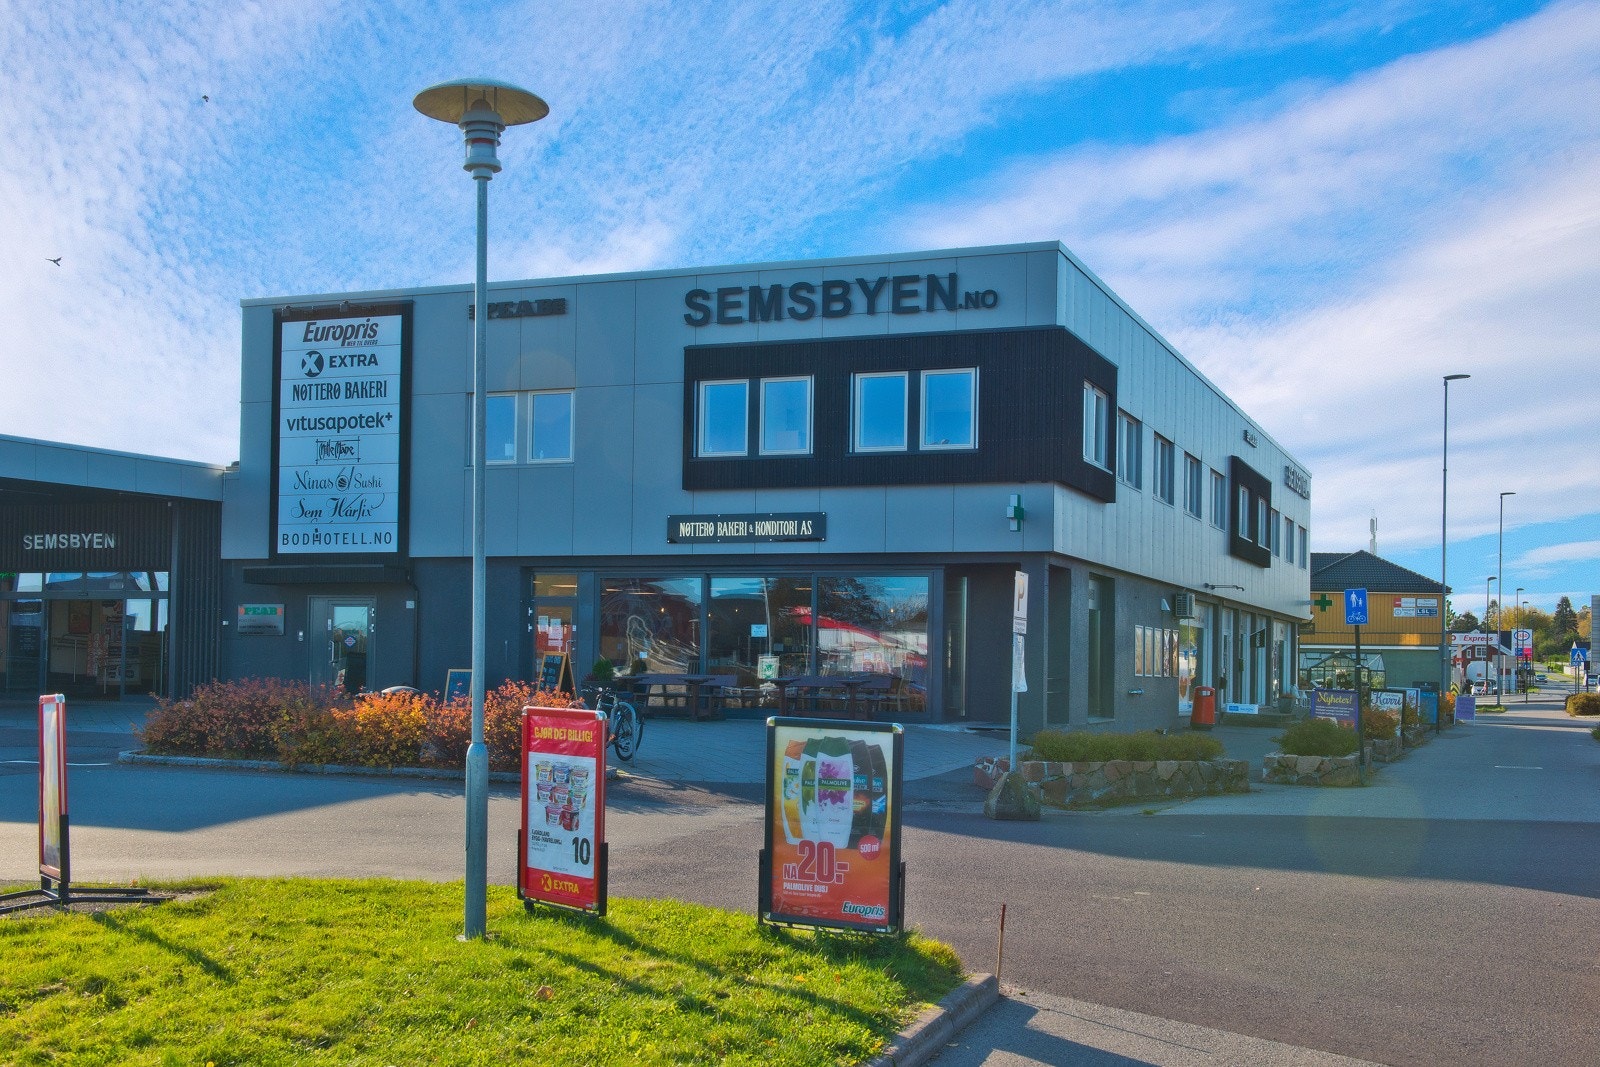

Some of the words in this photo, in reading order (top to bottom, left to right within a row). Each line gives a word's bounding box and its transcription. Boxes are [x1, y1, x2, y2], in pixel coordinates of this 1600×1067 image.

[683, 272, 998, 327] SEMSBYEN.NO
[302, 318, 379, 347] Europris
[329, 354, 379, 369] EXTRA
[292, 383, 341, 402] NØTTERØ
[345, 380, 387, 400] BAKERI
[293, 470, 334, 490] Ninas
[354, 473, 382, 489] Sushi
[291, 498, 323, 519] Sem
[716, 521, 747, 537] BAKERI
[755, 520, 798, 536] KONDITORI
[801, 520, 813, 535] AS
[23, 533, 115, 550] SEMSBYEN
[282, 530, 392, 546] BODHOTELL.NO
[534, 726, 553, 739] GJØR
[554, 728, 567, 740] DET
[567, 729, 593, 743] BILLIG!
[572, 836, 591, 866] 10
[860, 843, 871, 853] 500
[782, 862, 798, 880] NÅ
[553, 879, 580, 894] EXTRA
[783, 882, 813, 892] PALMOLIVE
[841, 901, 886, 917] Europris
